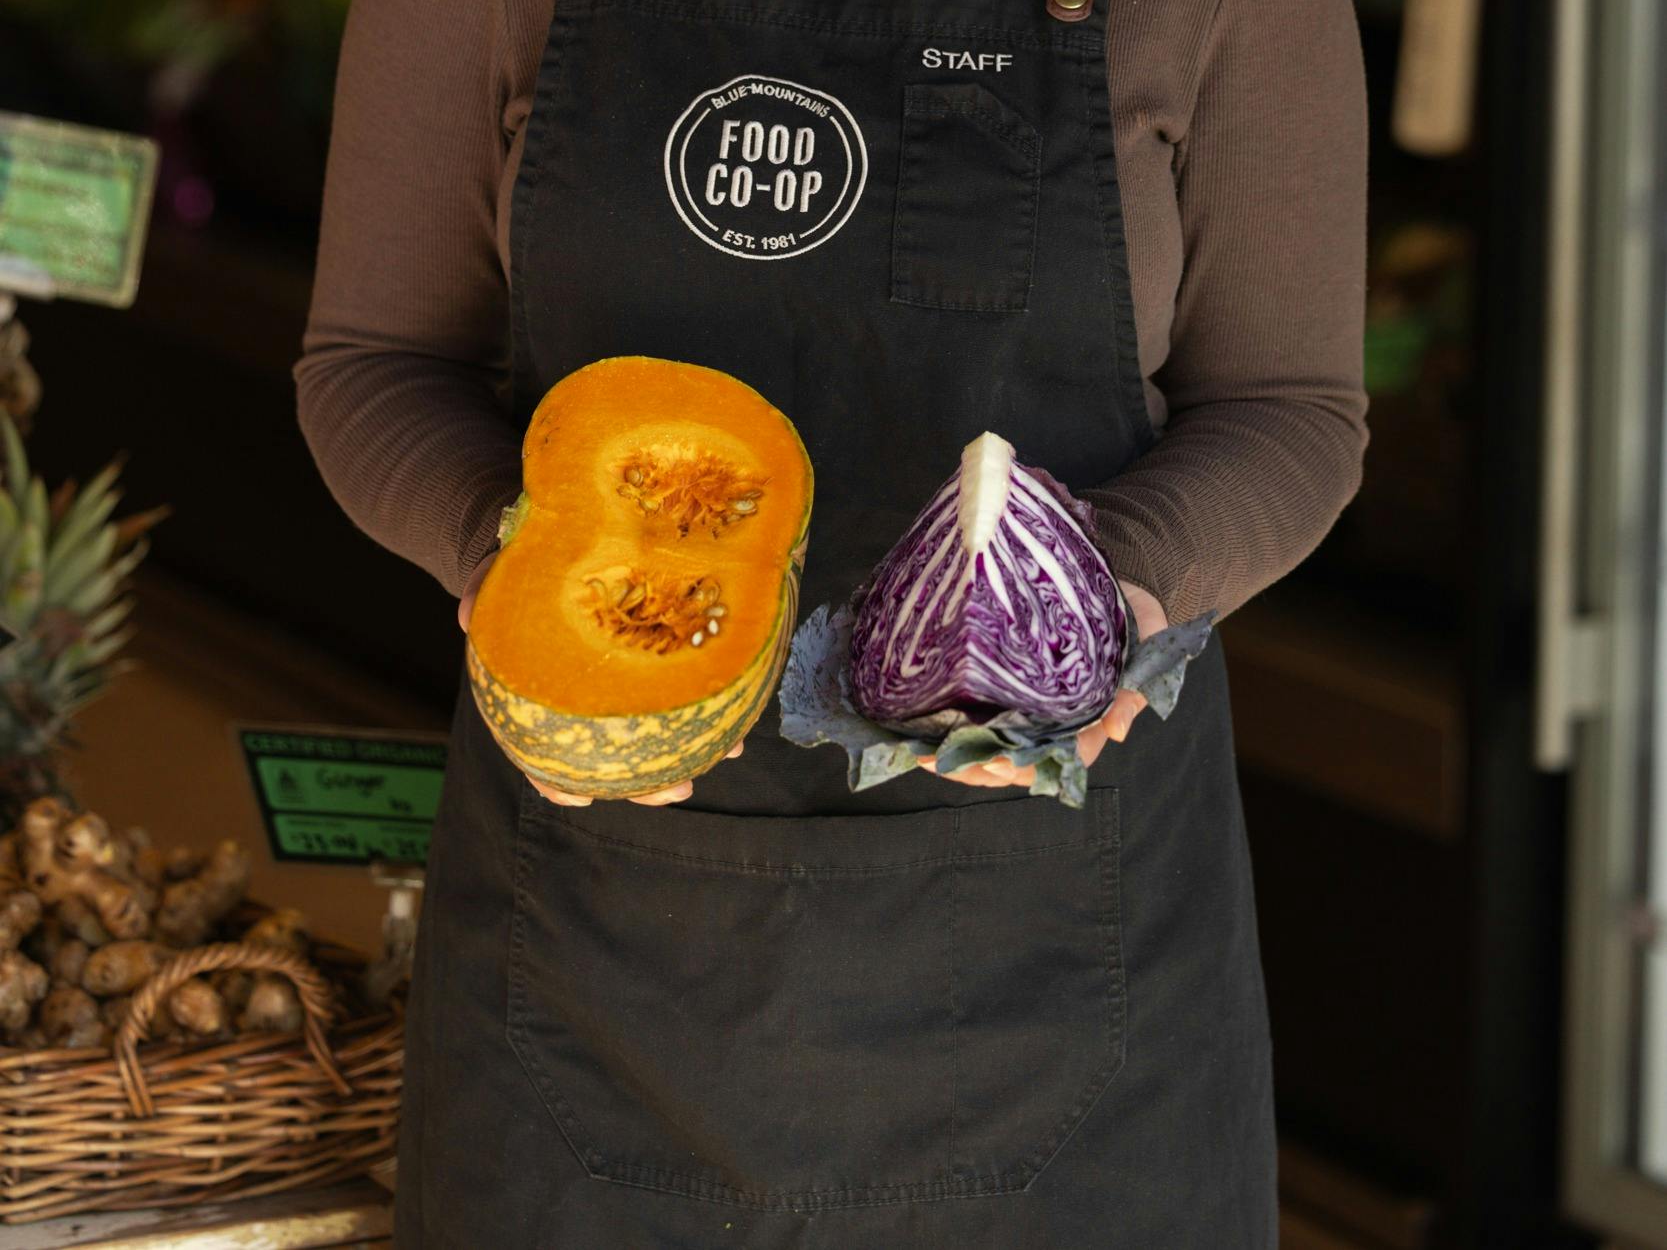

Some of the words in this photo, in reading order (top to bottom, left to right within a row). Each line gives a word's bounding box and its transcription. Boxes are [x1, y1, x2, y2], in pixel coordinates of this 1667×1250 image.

[922, 48, 1012, 72] STAFF
[711, 85, 749, 109] BLUE
[750, 83, 830, 117] MOUNTAINS
[720, 120, 815, 165] FOOD
[706, 163, 822, 212] CO-OP
[722, 229, 755, 249] EST.
[761, 233, 796, 250] 1981
